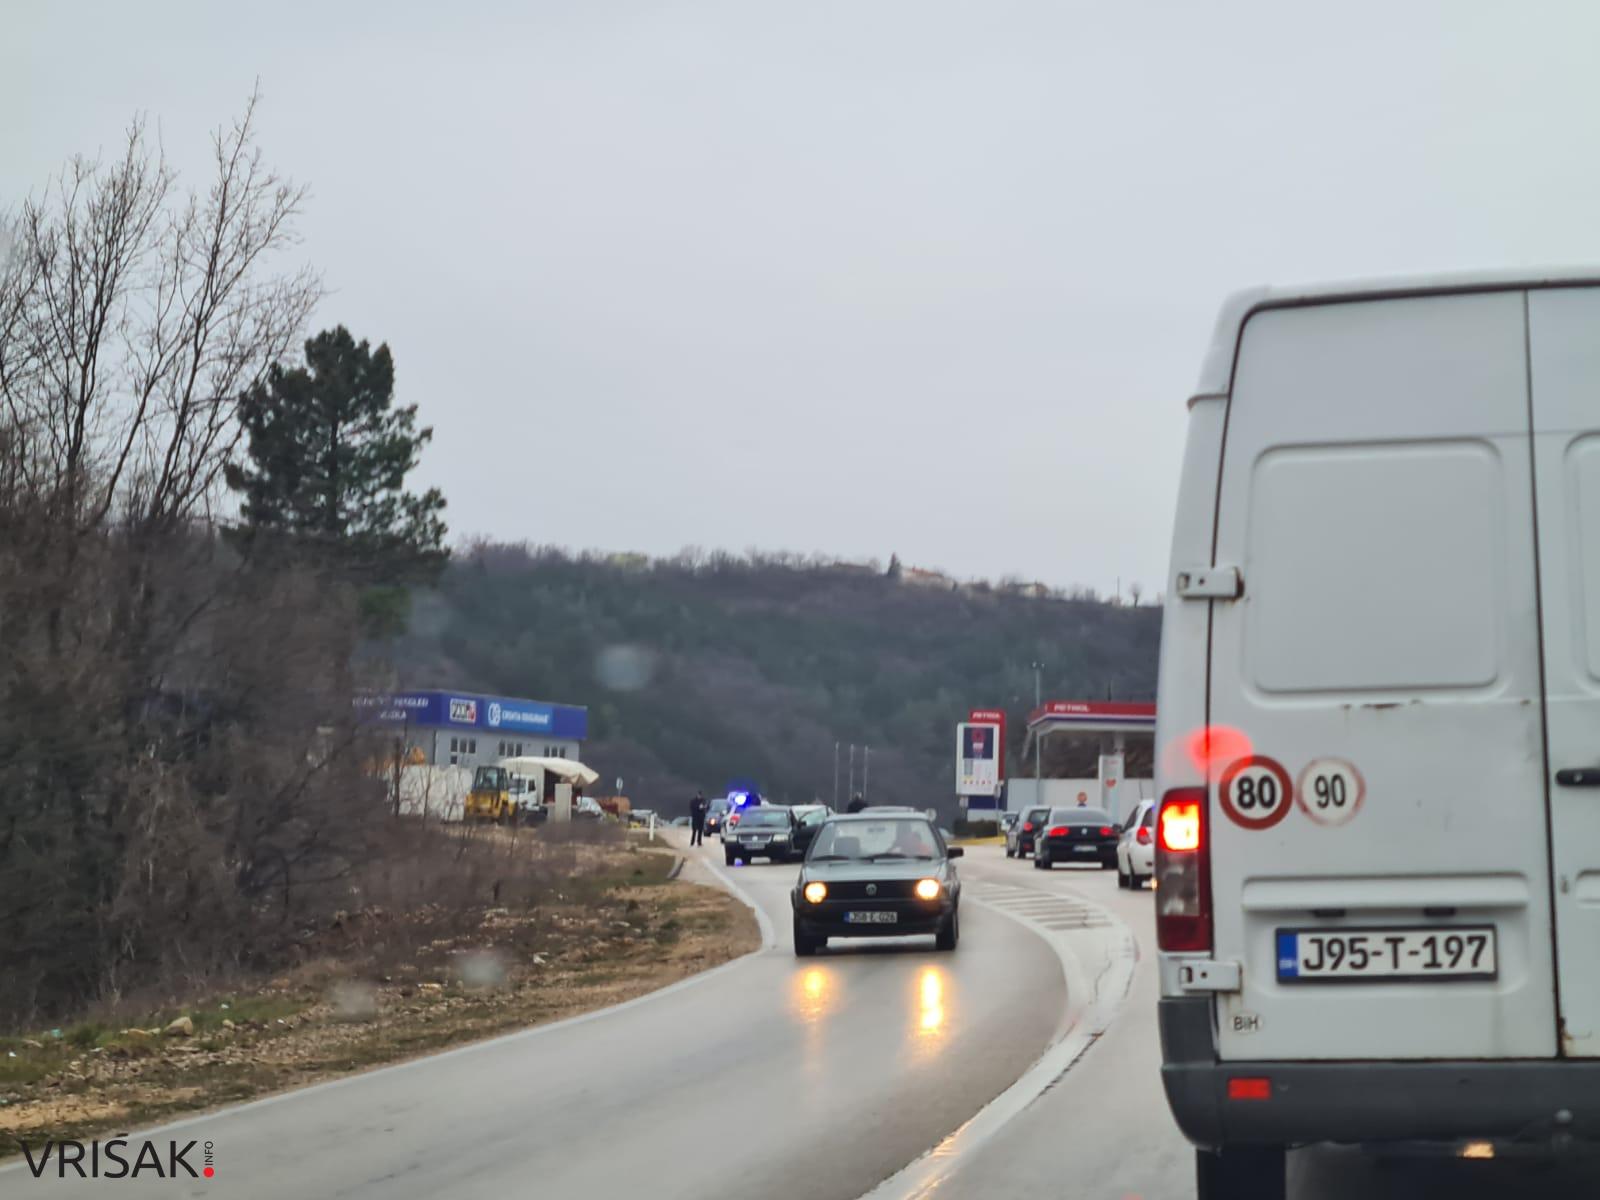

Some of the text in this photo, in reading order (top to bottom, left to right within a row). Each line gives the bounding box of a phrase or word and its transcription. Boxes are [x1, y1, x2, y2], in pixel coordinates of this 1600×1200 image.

[1237, 775, 1276, 810] 80
[1314, 774, 1346, 809] 90
[1303, 935, 1488, 971] J95-T-197
